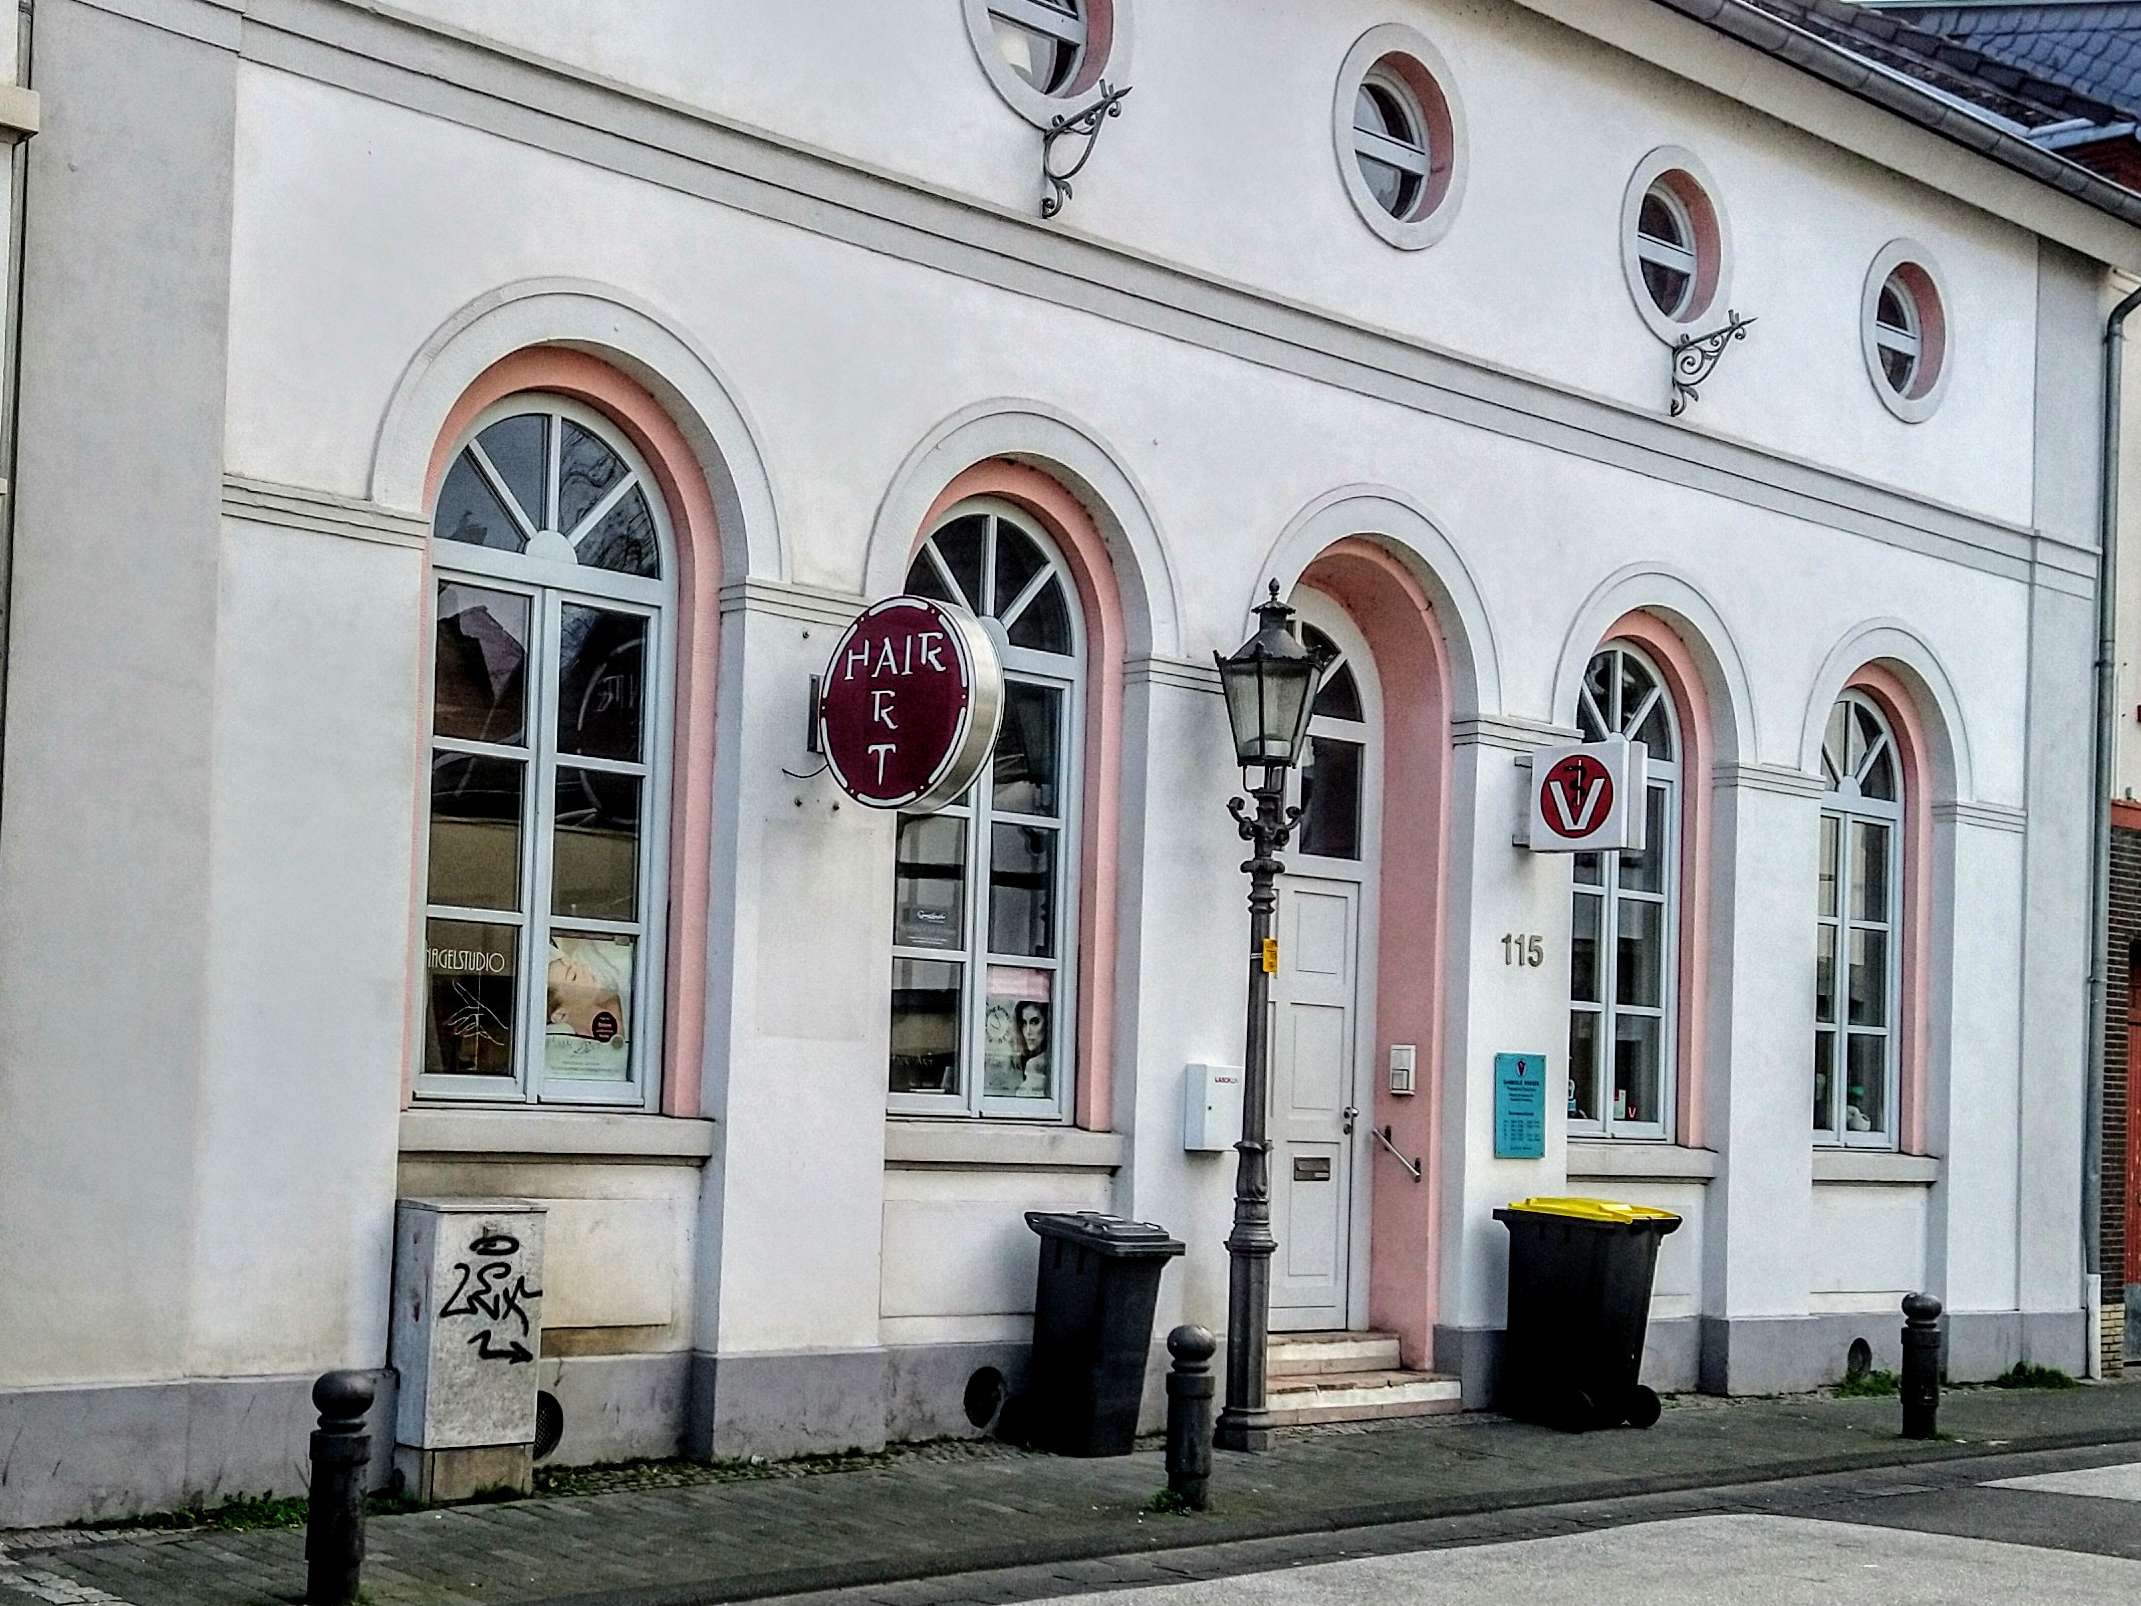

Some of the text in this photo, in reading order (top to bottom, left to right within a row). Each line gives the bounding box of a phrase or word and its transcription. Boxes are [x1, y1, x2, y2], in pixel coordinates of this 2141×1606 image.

[844, 632, 946, 680] HAIR
[1549, 778, 1605, 830] V
[1501, 933, 1543, 967] 115
